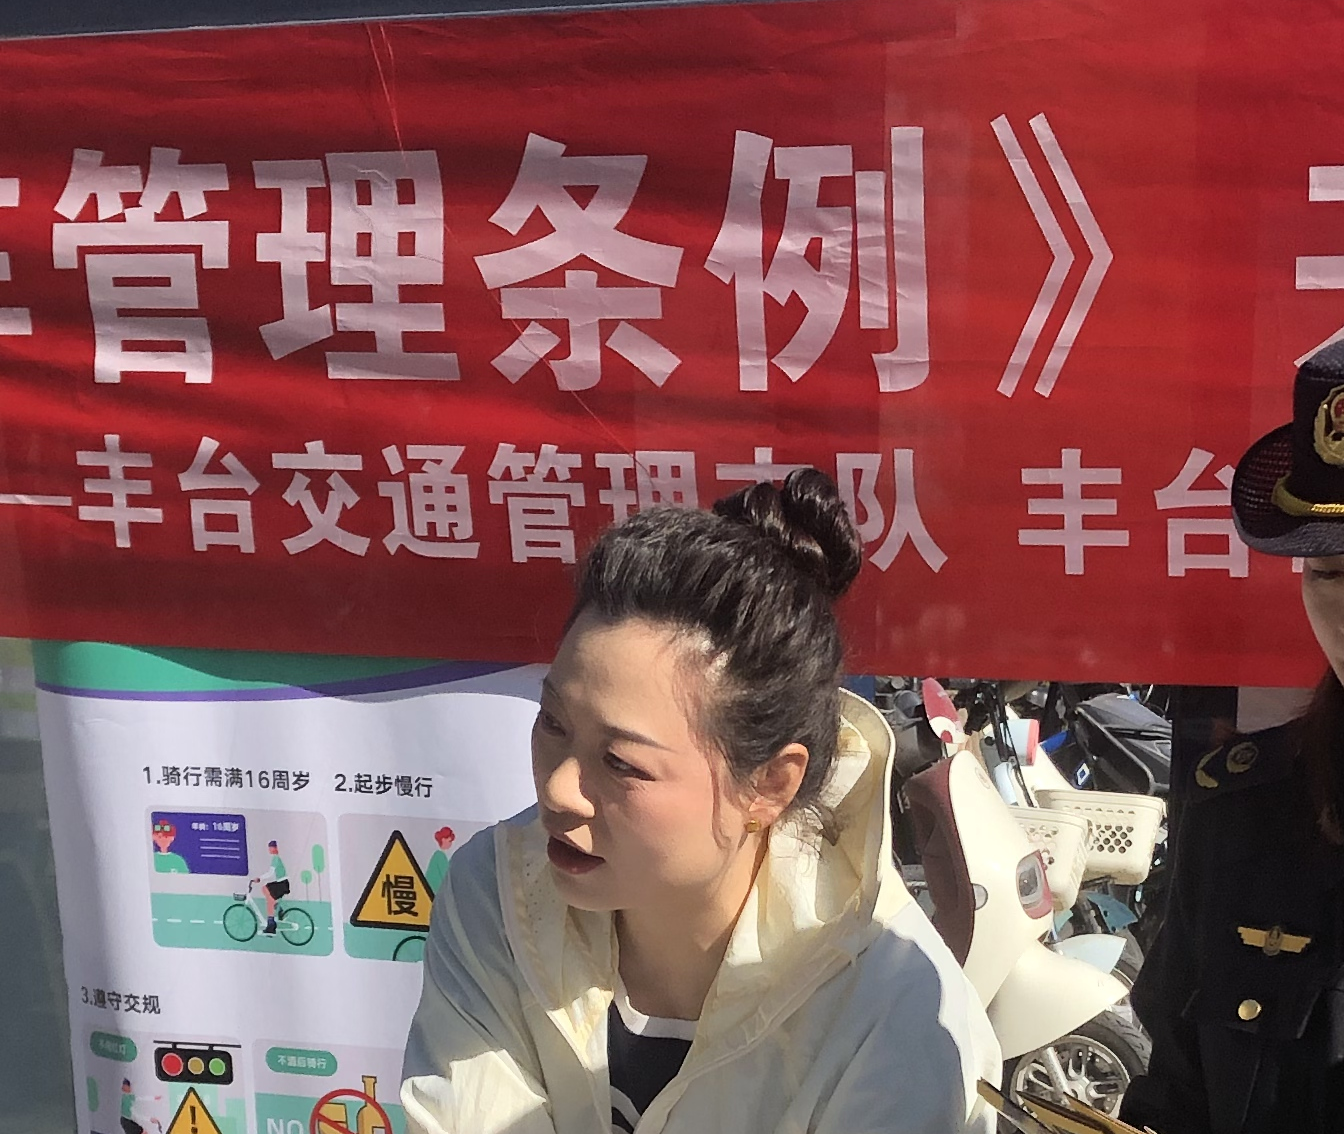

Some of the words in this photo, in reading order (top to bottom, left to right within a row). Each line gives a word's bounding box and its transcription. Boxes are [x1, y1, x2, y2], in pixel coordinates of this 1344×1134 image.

[143, 765, 311, 792] 1.骑行需满16周岁
[334, 773, 434, 799] 2.起步慢行
[381, 873, 419, 918] 慢
[81, 986, 161, 1016] 3.遵守交规
